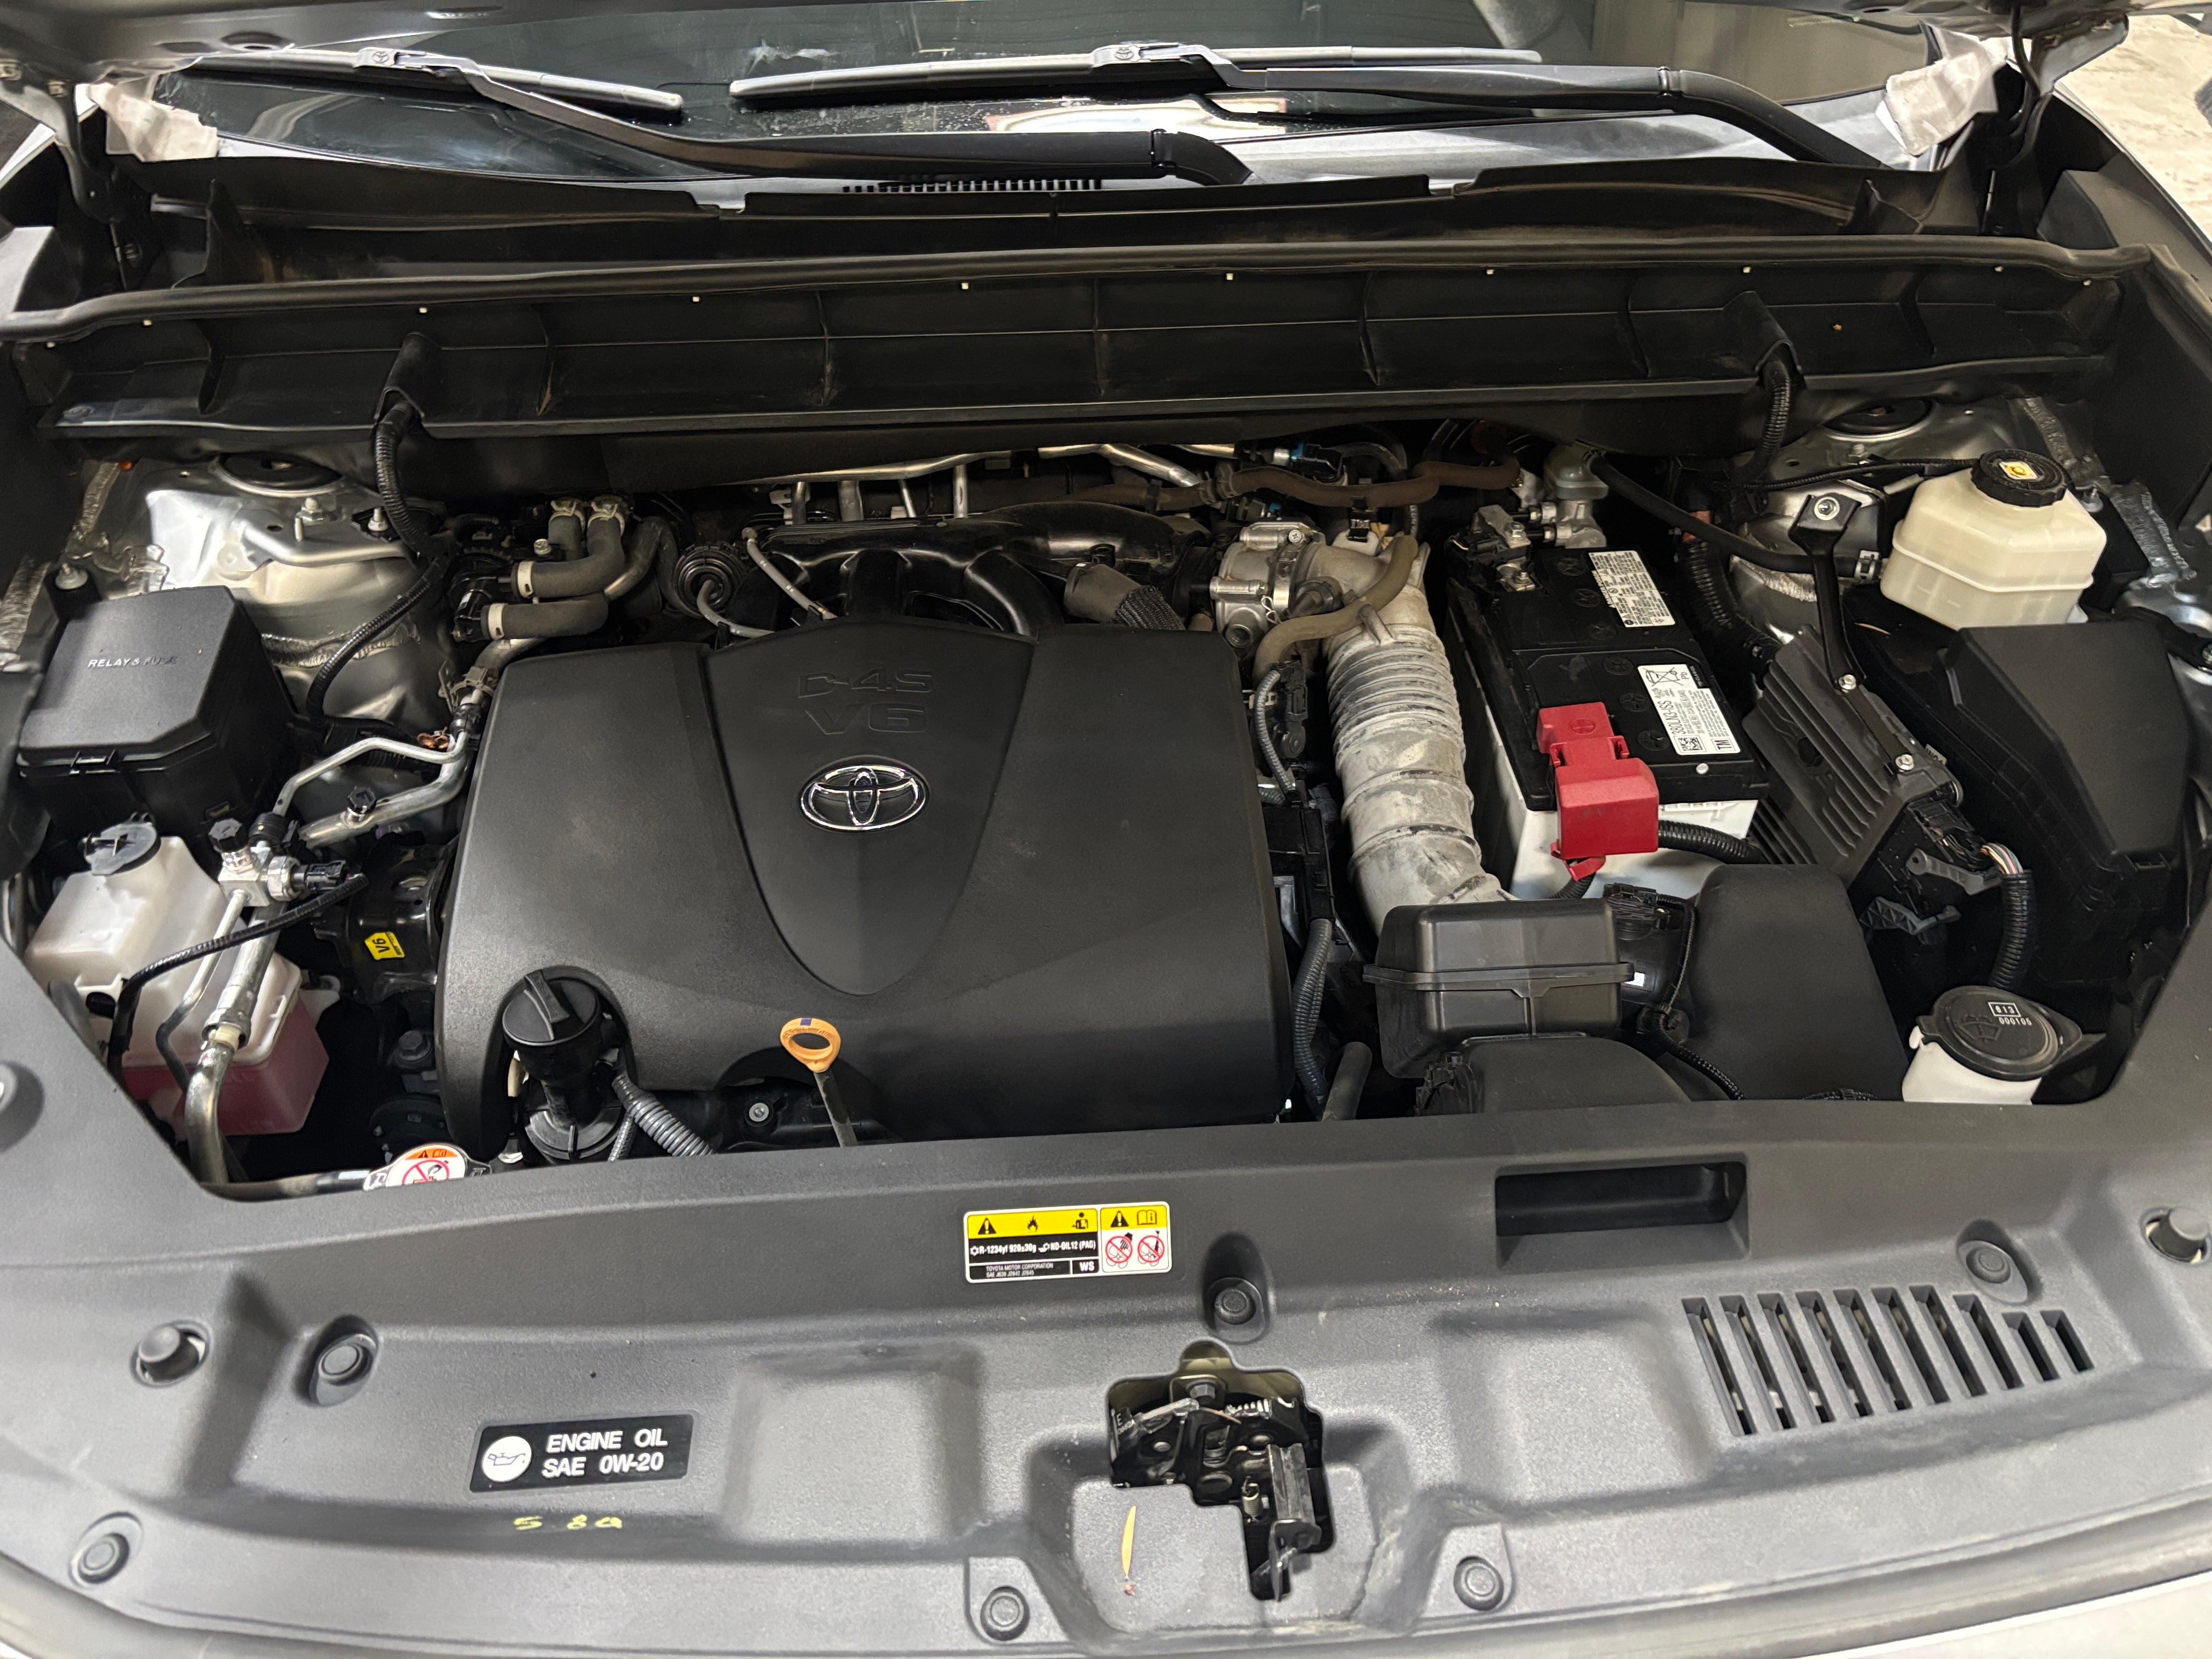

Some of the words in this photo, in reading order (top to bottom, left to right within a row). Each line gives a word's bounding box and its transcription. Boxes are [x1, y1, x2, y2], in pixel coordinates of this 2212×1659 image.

[805, 703, 927, 735] V6
[1714, 740, 1733, 750] TM
[372, 938, 390, 953] V6
[979, 1245, 1008, 1255] R-1234yf
[1079, 1240, 1096, 1250] (PAG)
[1080, 1261, 1095, 1272] WS
[546, 1431, 623, 1453] ENGINE
[634, 1429, 668, 1448] OIL
[541, 1457, 586, 1479] SAE
[599, 1452, 664, 1474] 0W-20
